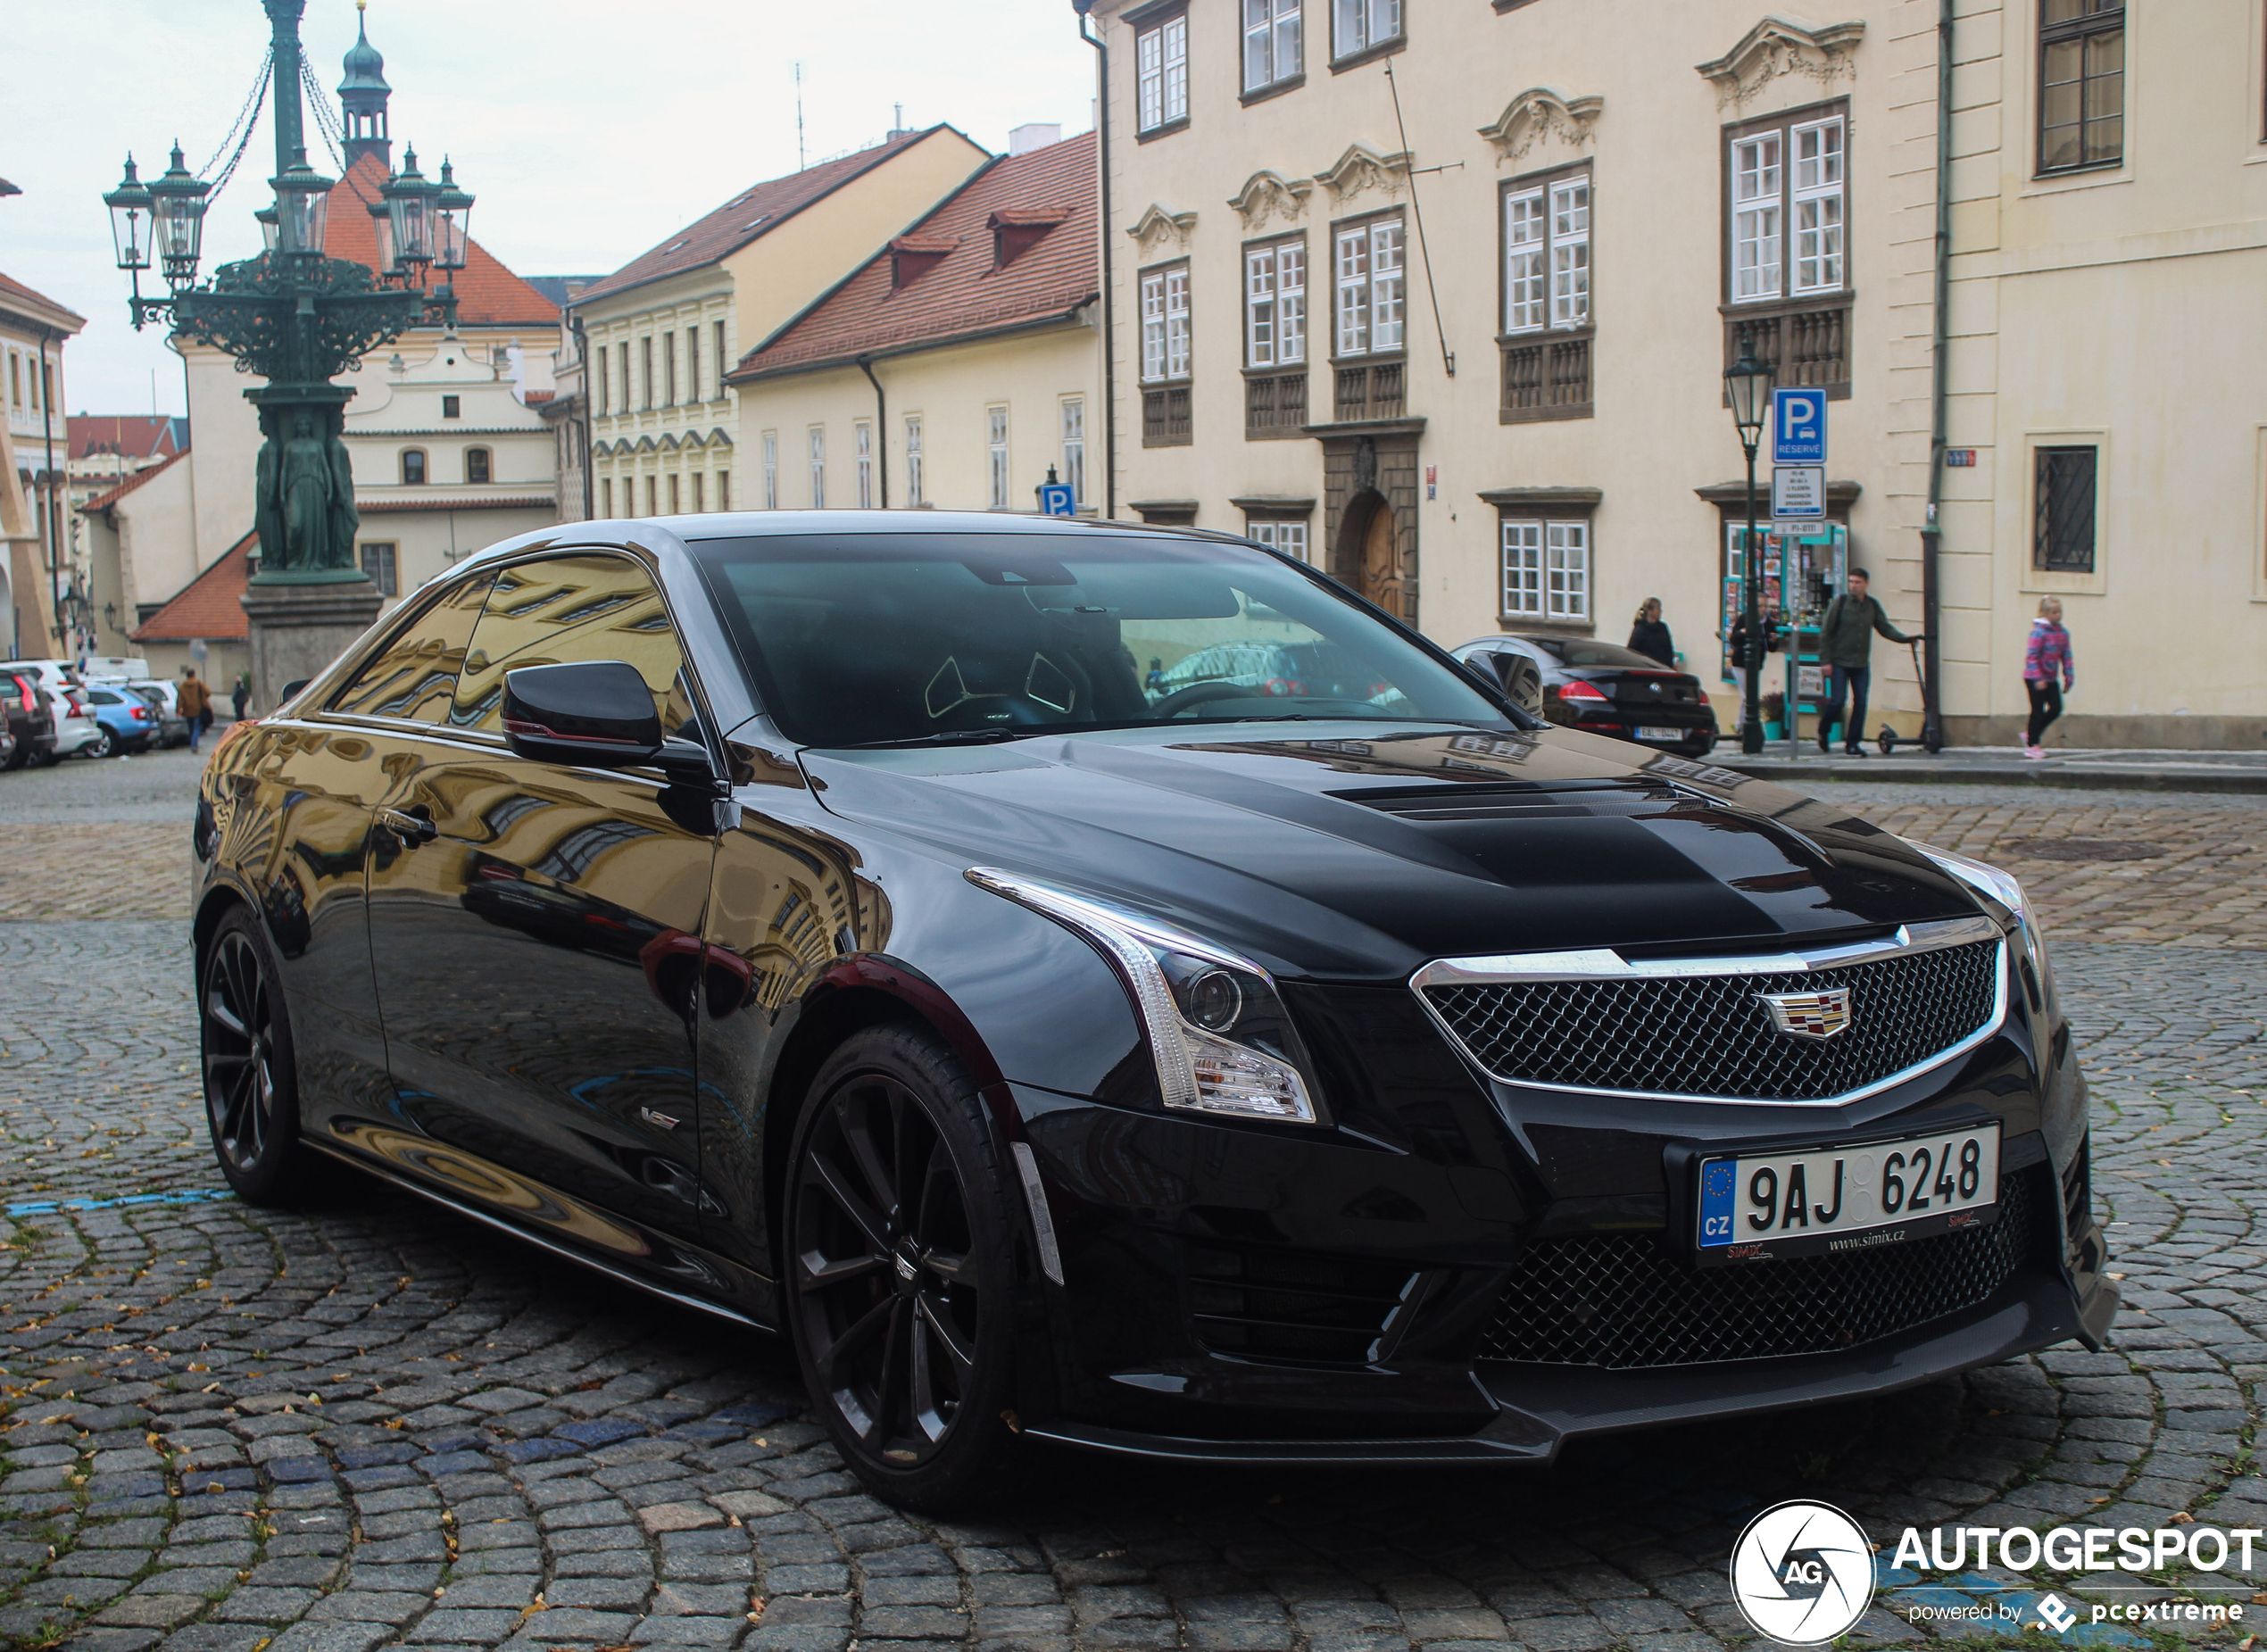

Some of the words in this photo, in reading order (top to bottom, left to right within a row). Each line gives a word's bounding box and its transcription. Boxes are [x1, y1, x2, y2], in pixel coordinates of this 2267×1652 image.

[1785, 397, 1815, 439] P
[1048, 490, 1067, 515] P
[1747, 1158, 1845, 1231] 9AJ
[1881, 1138, 1981, 1215] 6248
[1706, 1216, 1730, 1236] CZ
[1829, 1230, 1906, 1250] www.simix.cz
